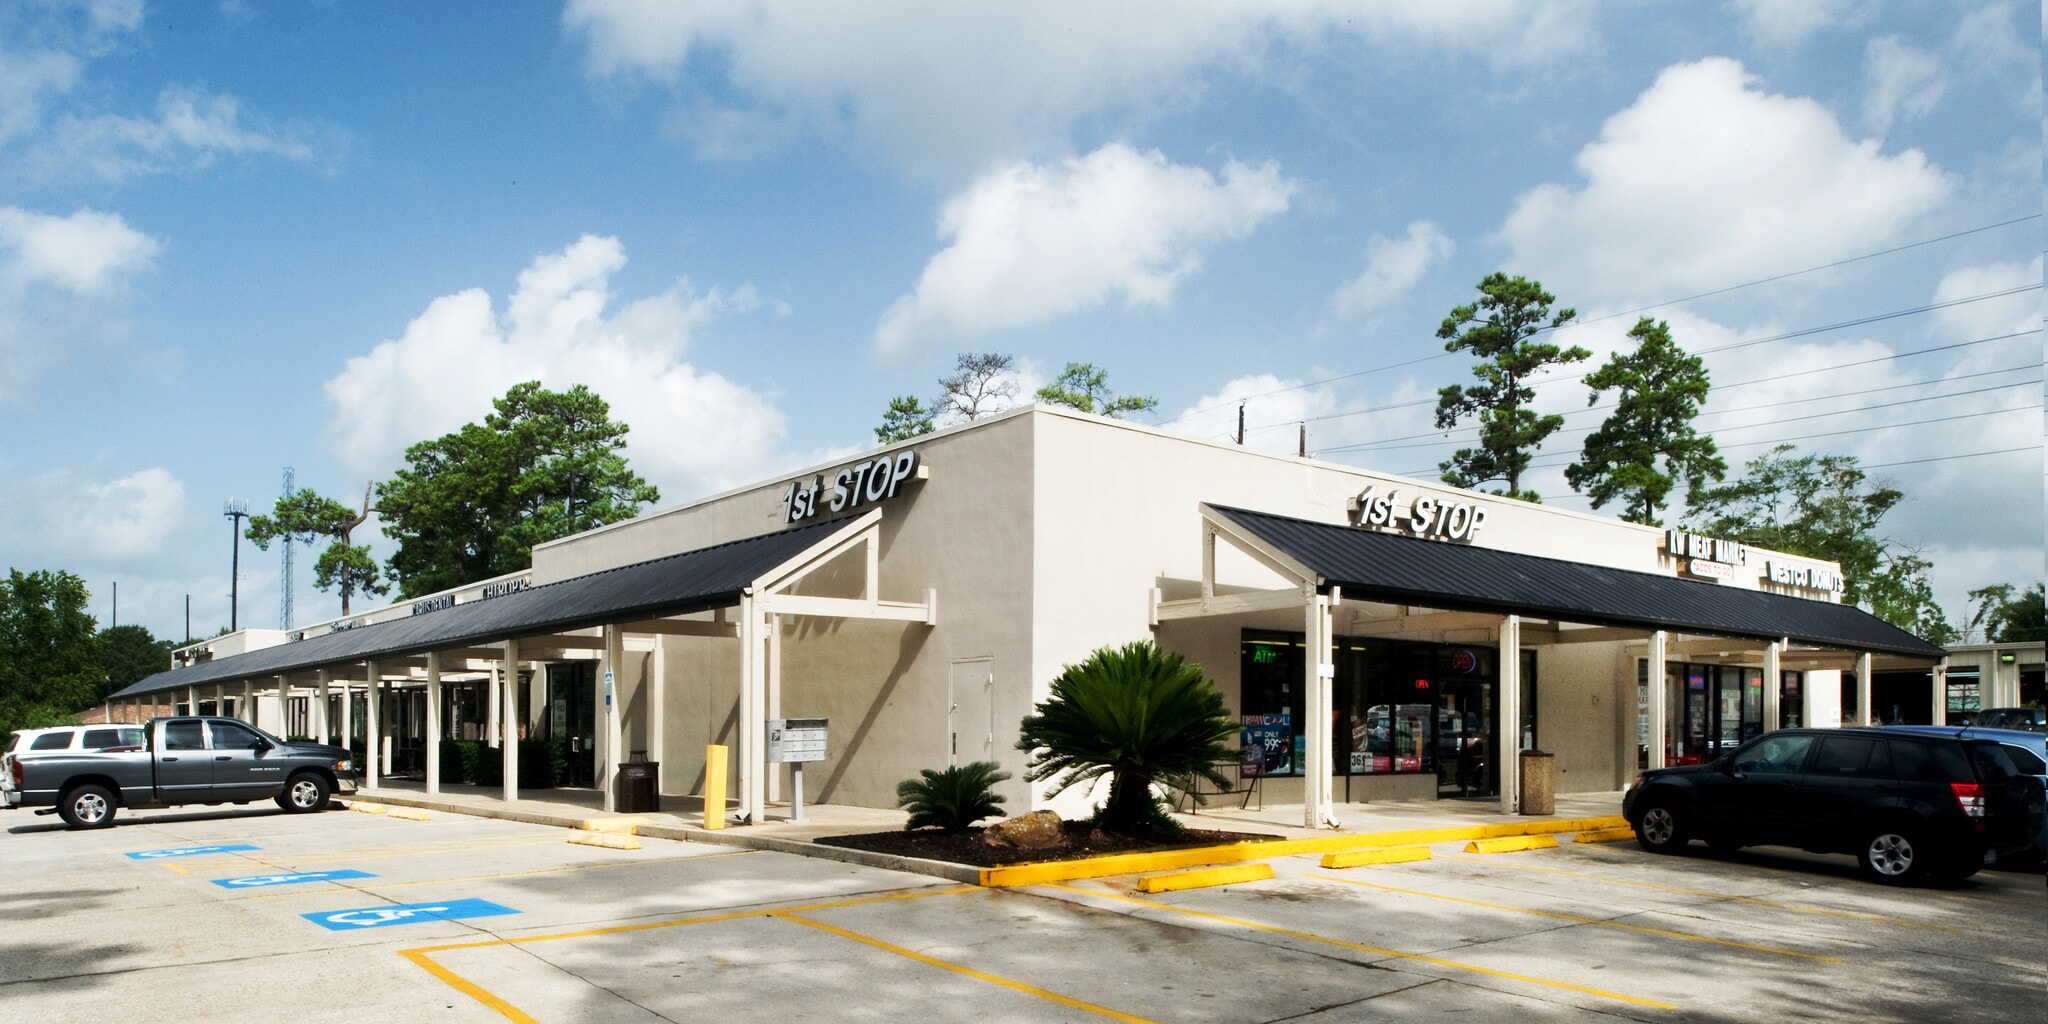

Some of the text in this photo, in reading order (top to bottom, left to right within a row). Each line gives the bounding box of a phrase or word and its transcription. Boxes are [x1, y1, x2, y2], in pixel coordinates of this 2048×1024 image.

[783, 450, 918, 523] 1st STOP
[1360, 485, 1489, 540] 1st STOP
[1670, 529, 1686, 555] KW
[1689, 533, 1712, 560] MEAT
[1693, 562, 1731, 577] TACOS TO GO
[1769, 560, 1845, 593] WESTCO DONUTS
